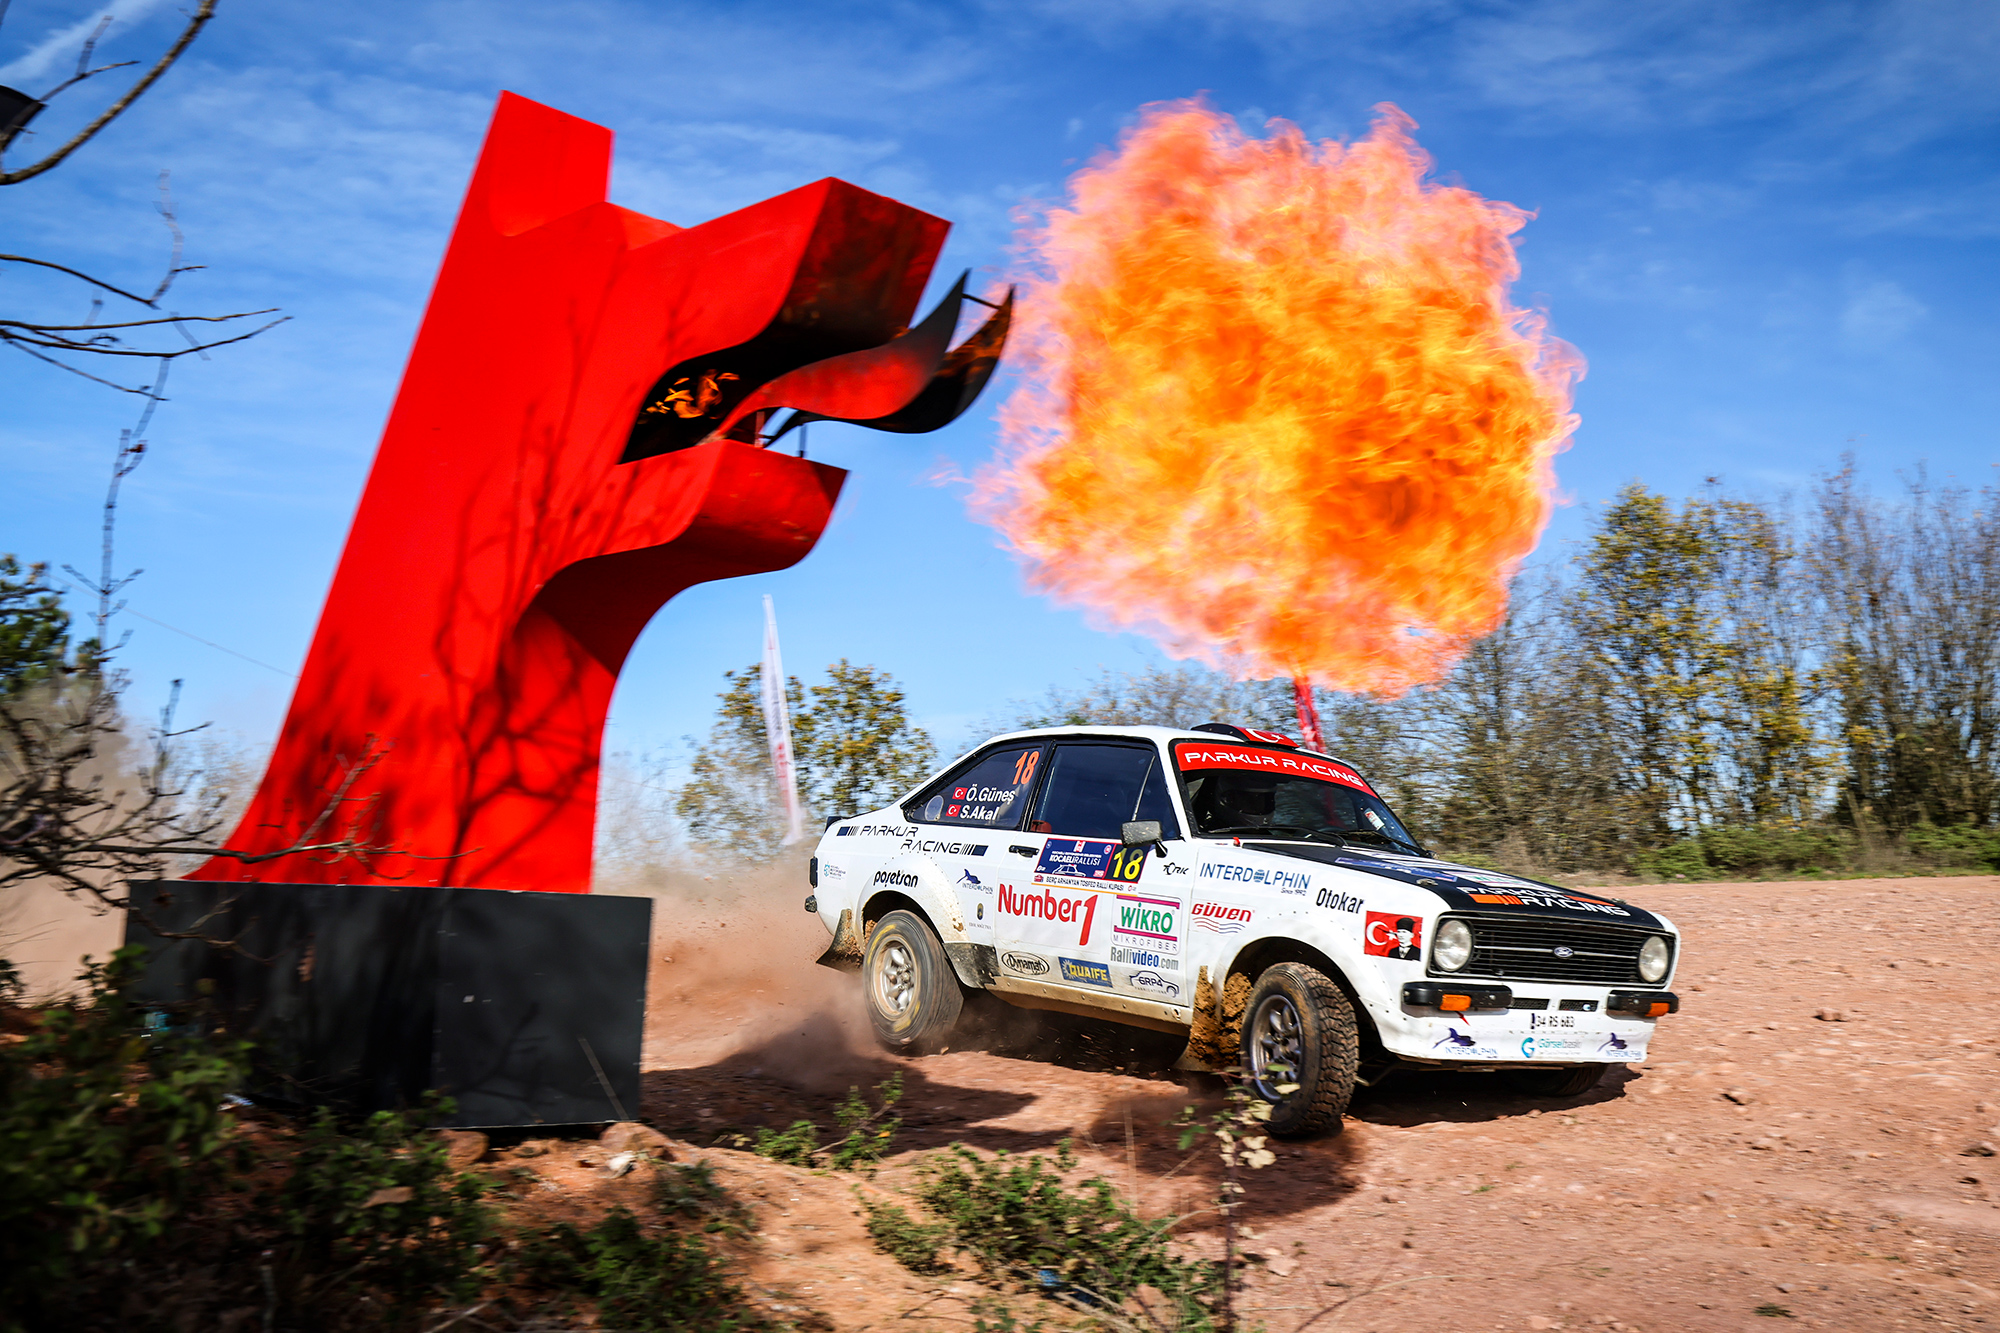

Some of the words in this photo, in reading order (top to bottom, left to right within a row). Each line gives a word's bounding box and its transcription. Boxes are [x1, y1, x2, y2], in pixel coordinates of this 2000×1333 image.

[1012, 750, 1040, 785] 18
[1185, 752, 1278, 767] PARKUR
[1282, 758, 1364, 787] RACING
[966, 783, 1016, 805] Ö.Güneş
[959, 805, 1000, 820] S.Akal
[859, 825, 919, 837] PARKUR
[900, 839, 962, 854] RACING
[1113, 848, 1144, 880] 18
[1315, 887, 1364, 914] Otokar
[1518, 895, 1631, 917] RACING
[1110, 946, 1179, 970] Rallivideo.com
[1069, 964, 1108, 981] QUAIFE
[1536, 1015, 1546, 1027] 34
[1549, 1015, 1559, 1028] RS
